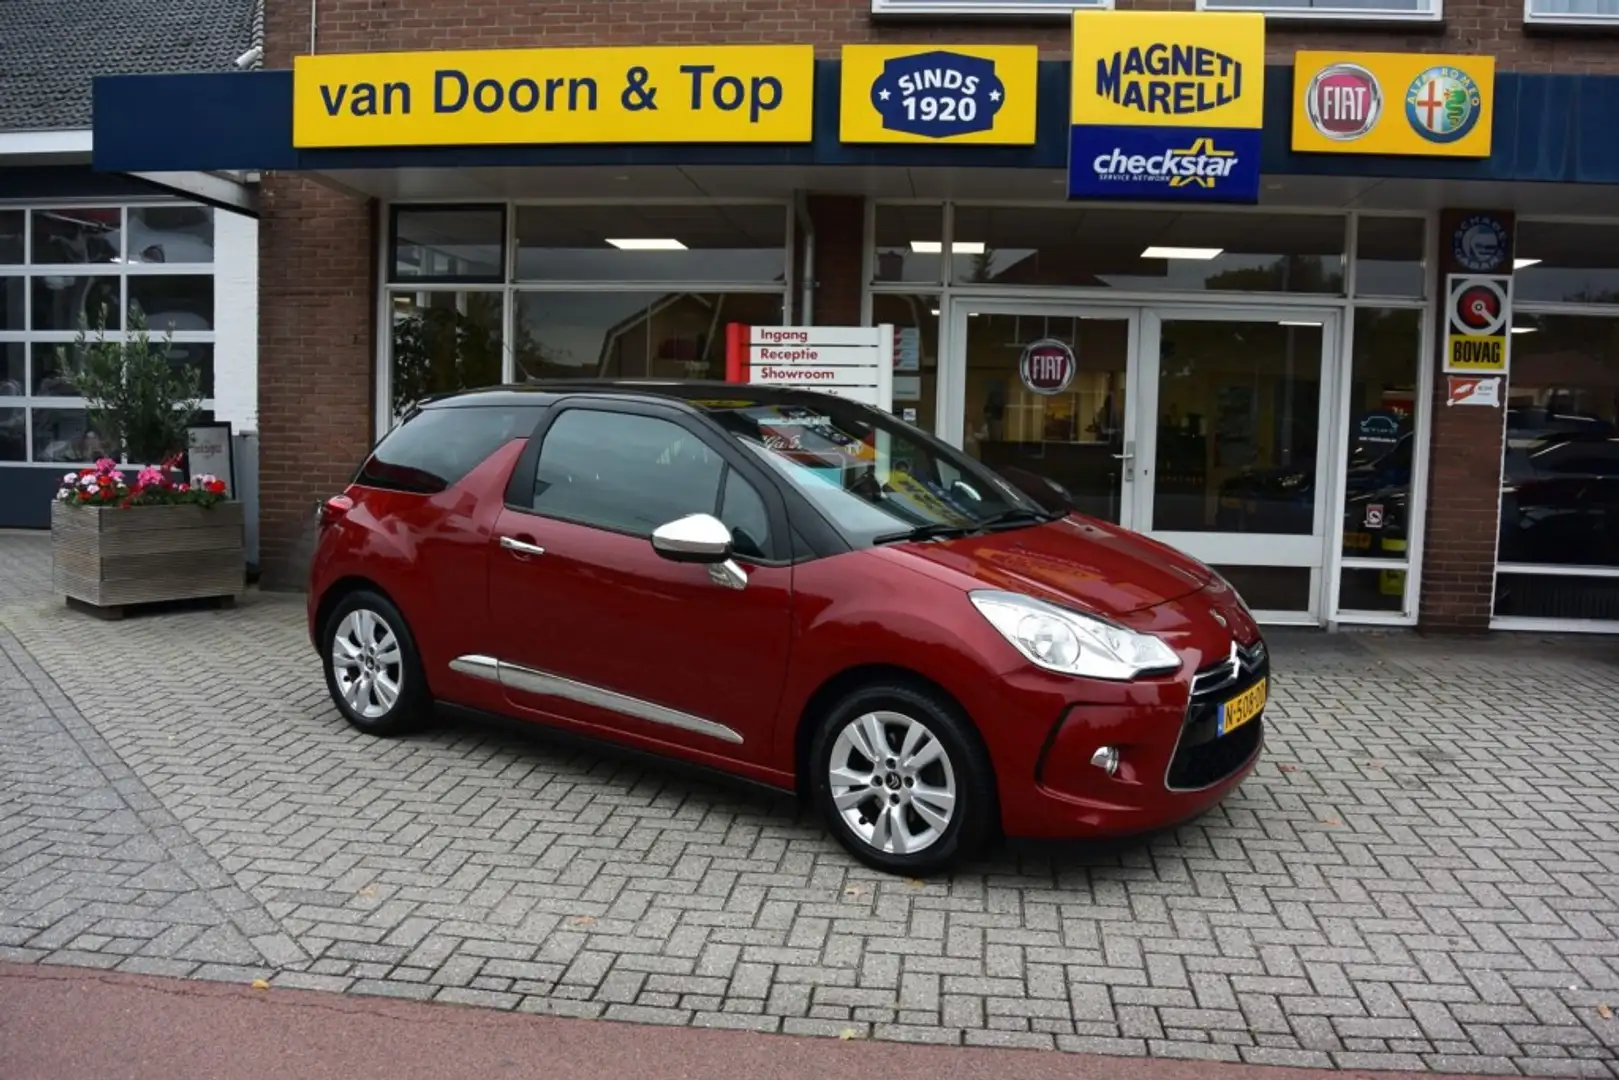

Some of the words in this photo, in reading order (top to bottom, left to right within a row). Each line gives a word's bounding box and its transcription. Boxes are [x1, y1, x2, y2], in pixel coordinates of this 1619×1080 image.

[897, 68, 980, 97] SINDS
[1097, 43, 1242, 100] MAGNETI
[319, 81, 411, 117] van
[433, 69, 598, 114] Doorn
[620, 66, 659, 111] &
[679, 64, 784, 123] Top
[1097, 58, 1242, 115] MARELLI
[901, 96, 977, 122] 1920
[1322, 86, 1367, 121] FIAT
[1092, 148, 1239, 177] checkstar
[1099, 173, 1130, 182] SERVICE
[760, 328, 808, 343] Ingang
[760, 348, 819, 363] Receptie
[1453, 340, 1501, 363] BOVAG
[760, 366, 835, 380] Showroom
[1032, 355, 1064, 380] FIAT
